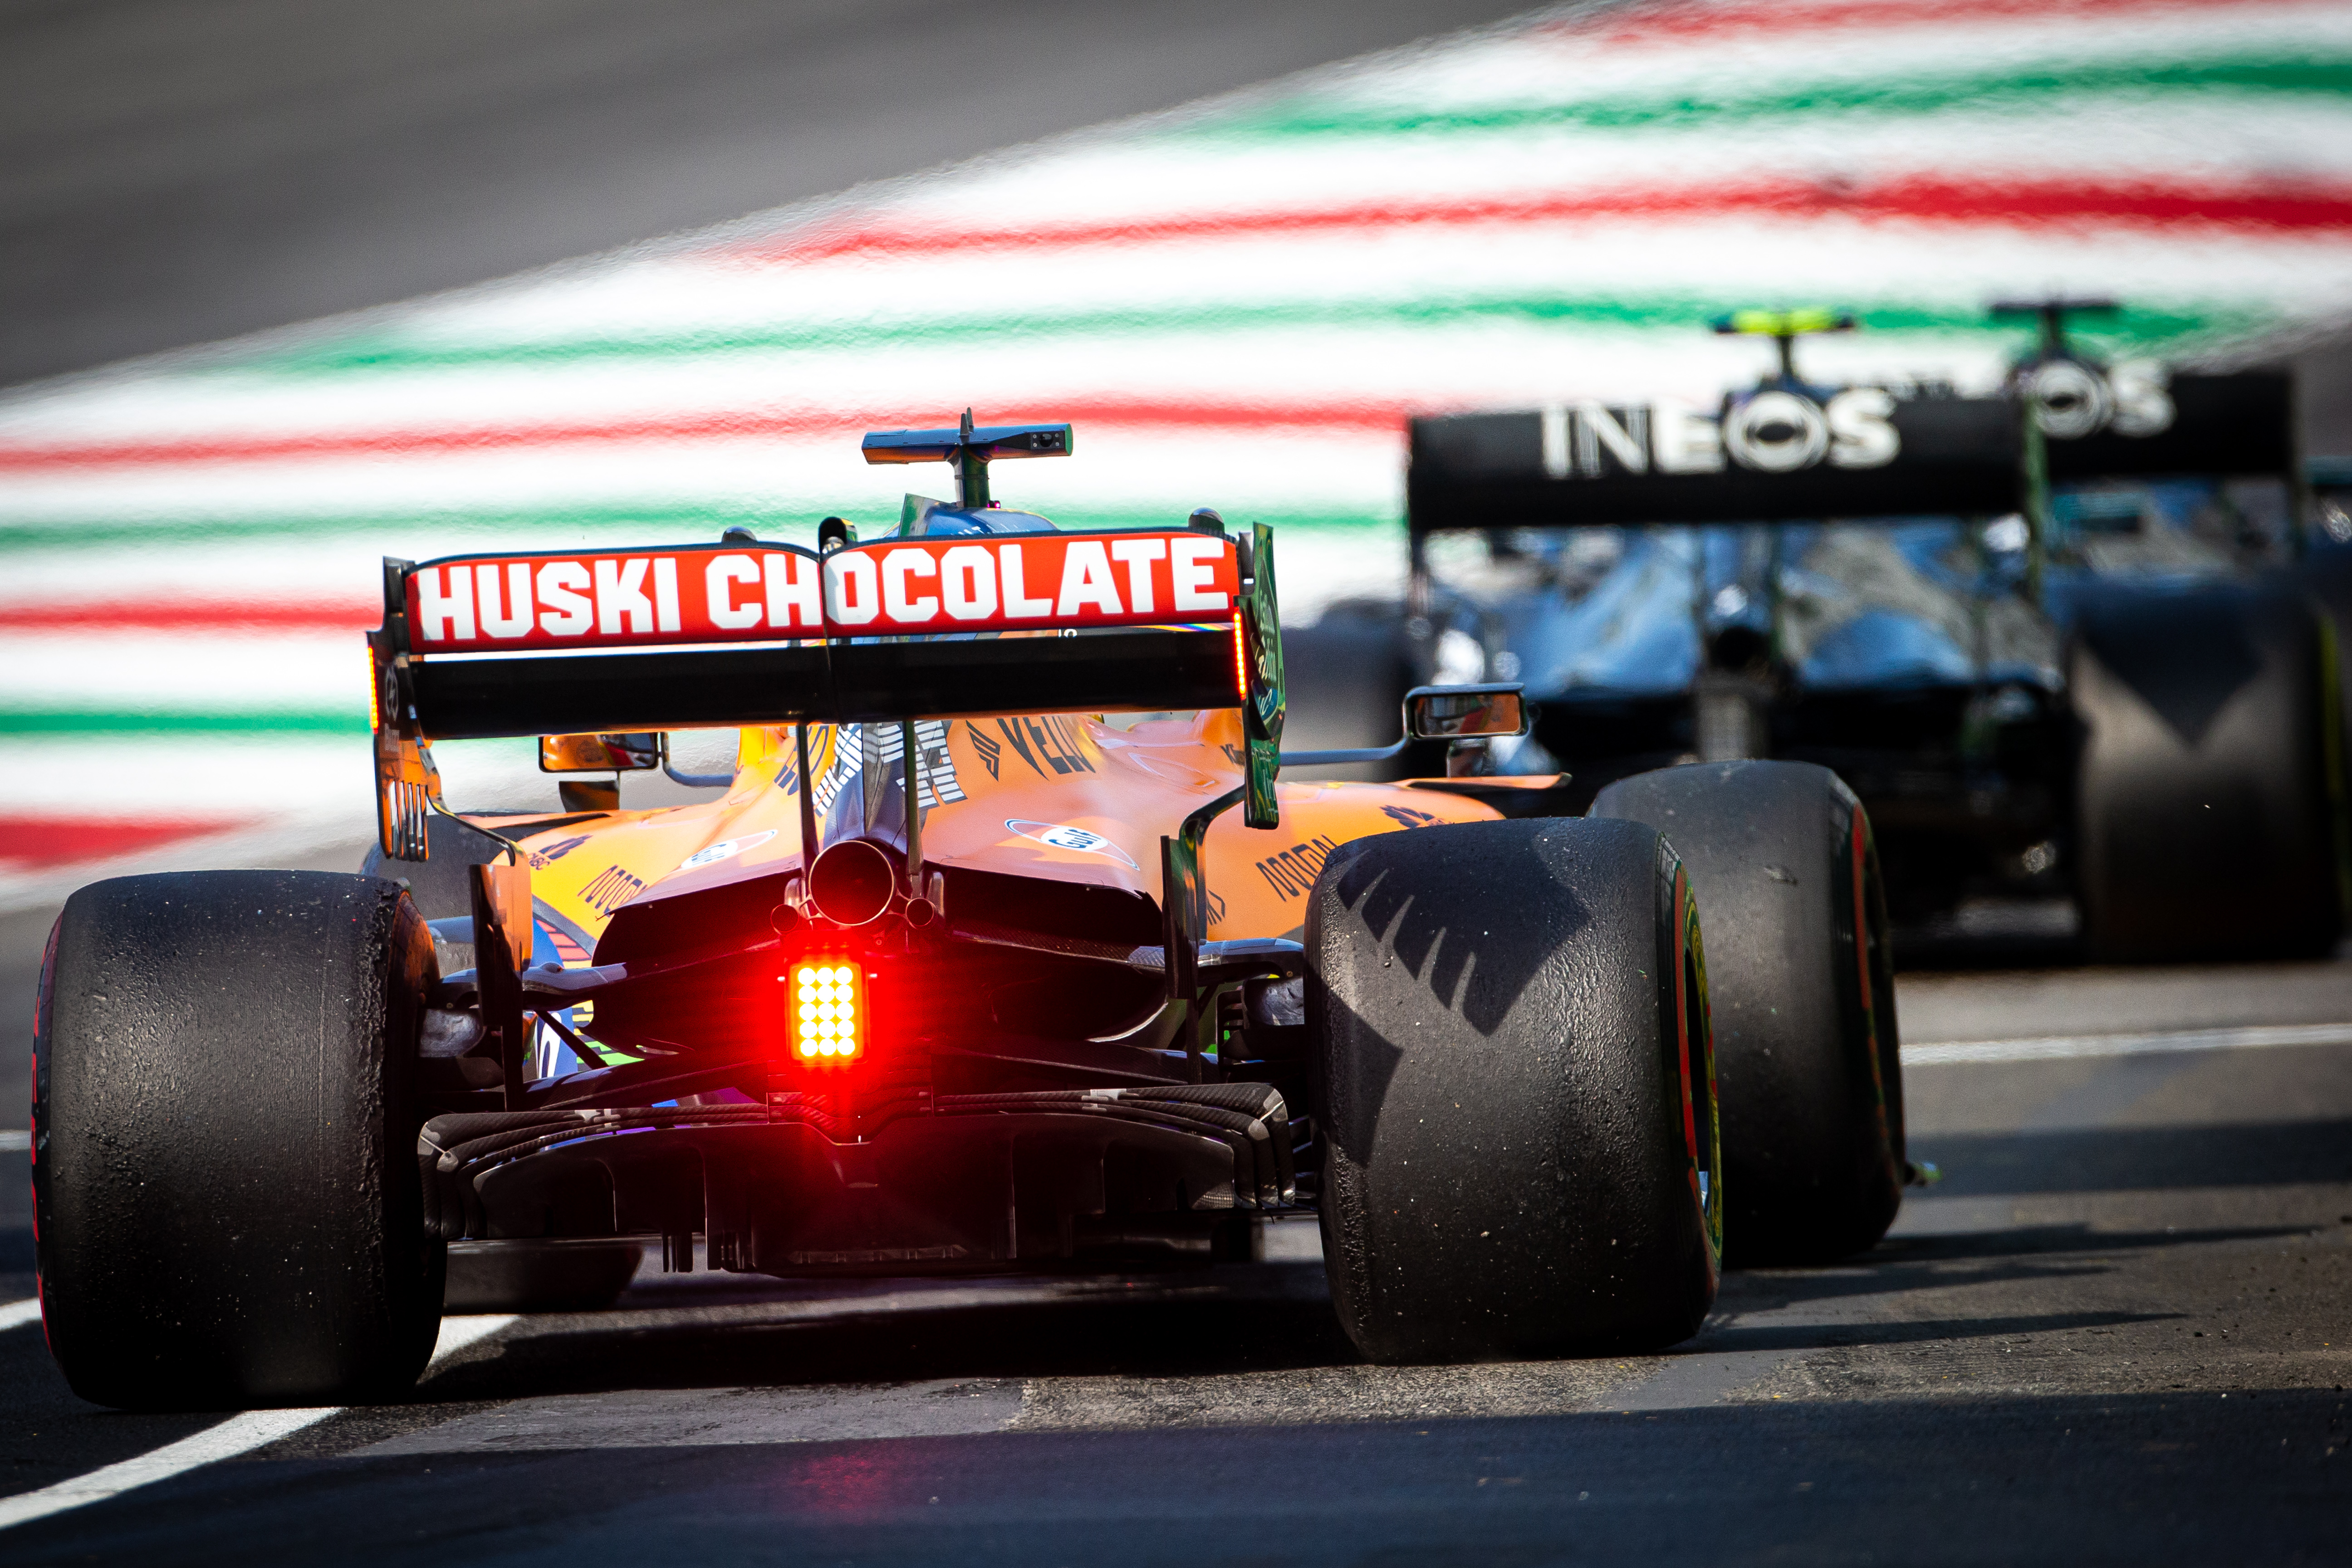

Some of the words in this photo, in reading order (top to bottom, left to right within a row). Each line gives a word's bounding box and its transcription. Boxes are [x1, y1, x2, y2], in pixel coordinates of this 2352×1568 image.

[1541, 389, 1901, 480] INEOS
[417, 557, 681, 641] HUSKI
[705, 537, 1229, 629] CHOCOLATE
[1048, 829, 1102, 848] Gulf
